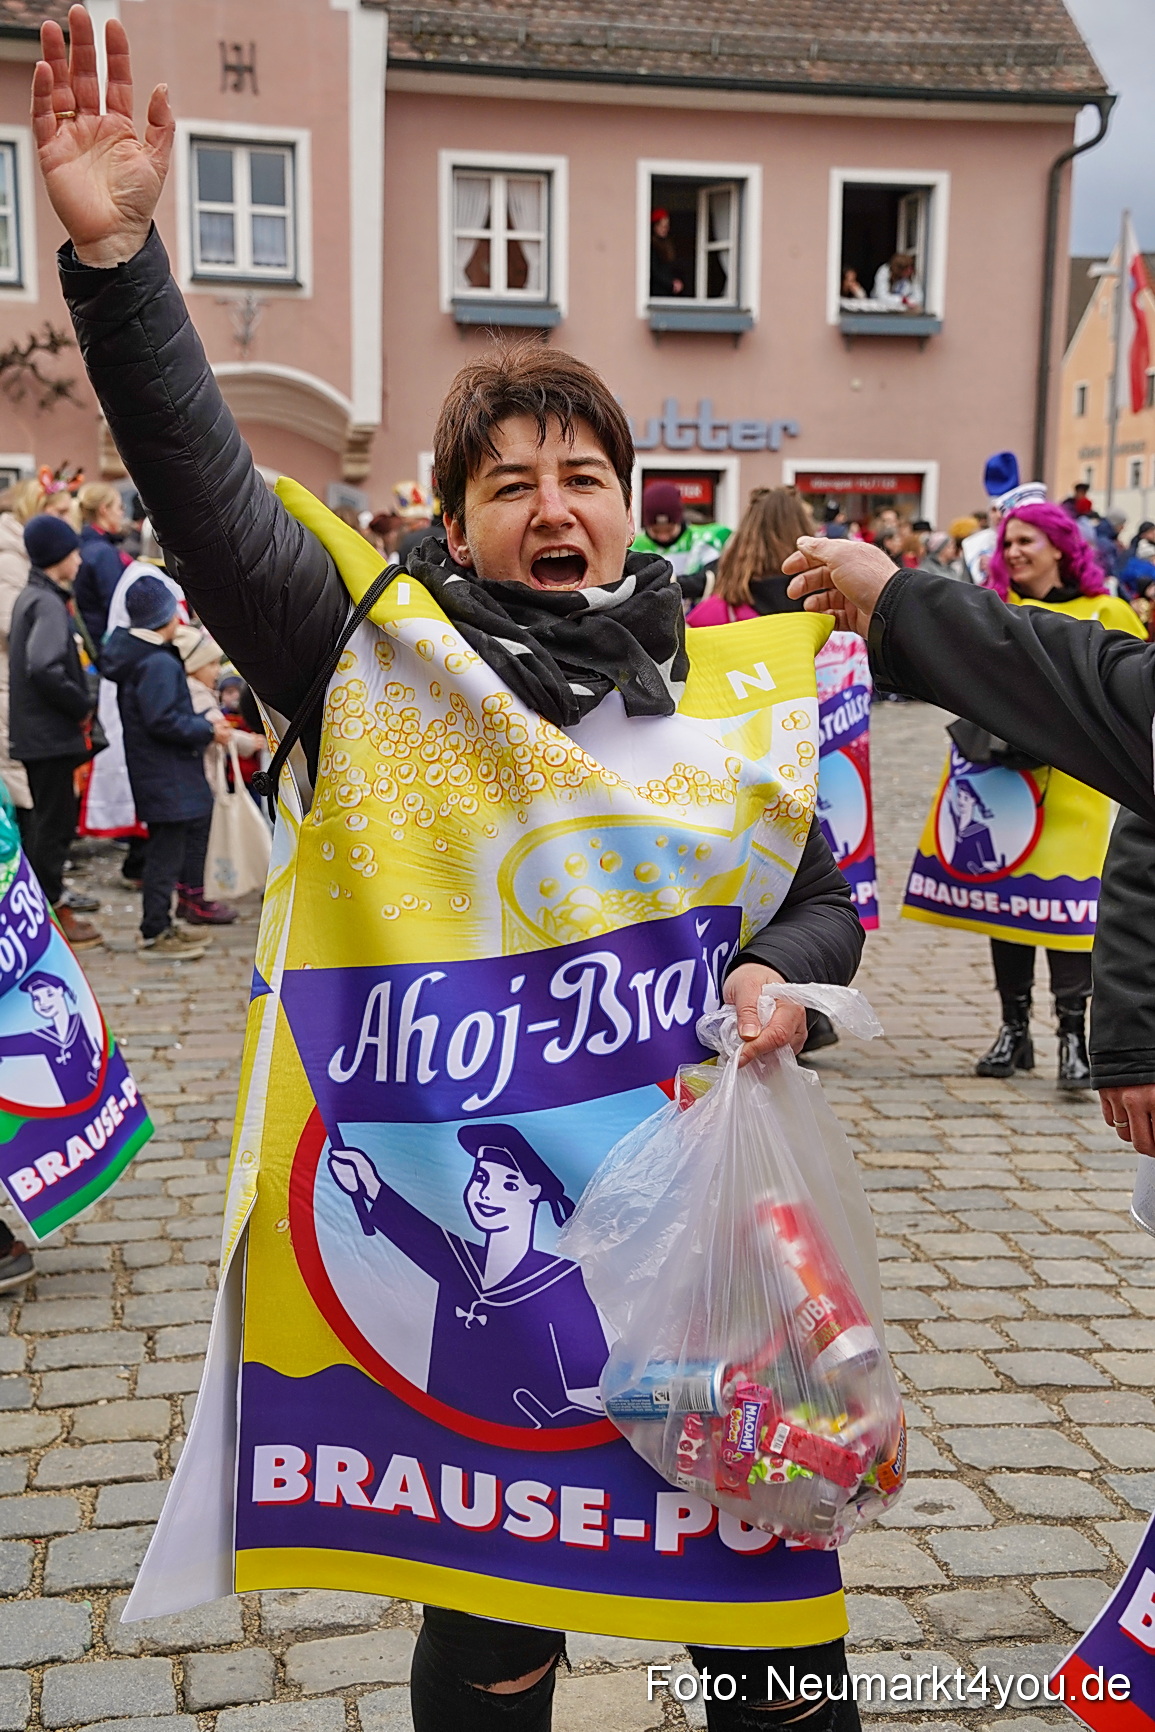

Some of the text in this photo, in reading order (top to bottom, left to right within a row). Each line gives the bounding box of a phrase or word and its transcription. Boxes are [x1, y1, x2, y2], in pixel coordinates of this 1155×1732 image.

[616, 395, 799, 452] utter
[726, 662, 776, 700] N
[740, 1404, 758, 1450] MAOAM
[251, 1444, 815, 1556] BRAUSE-PU
